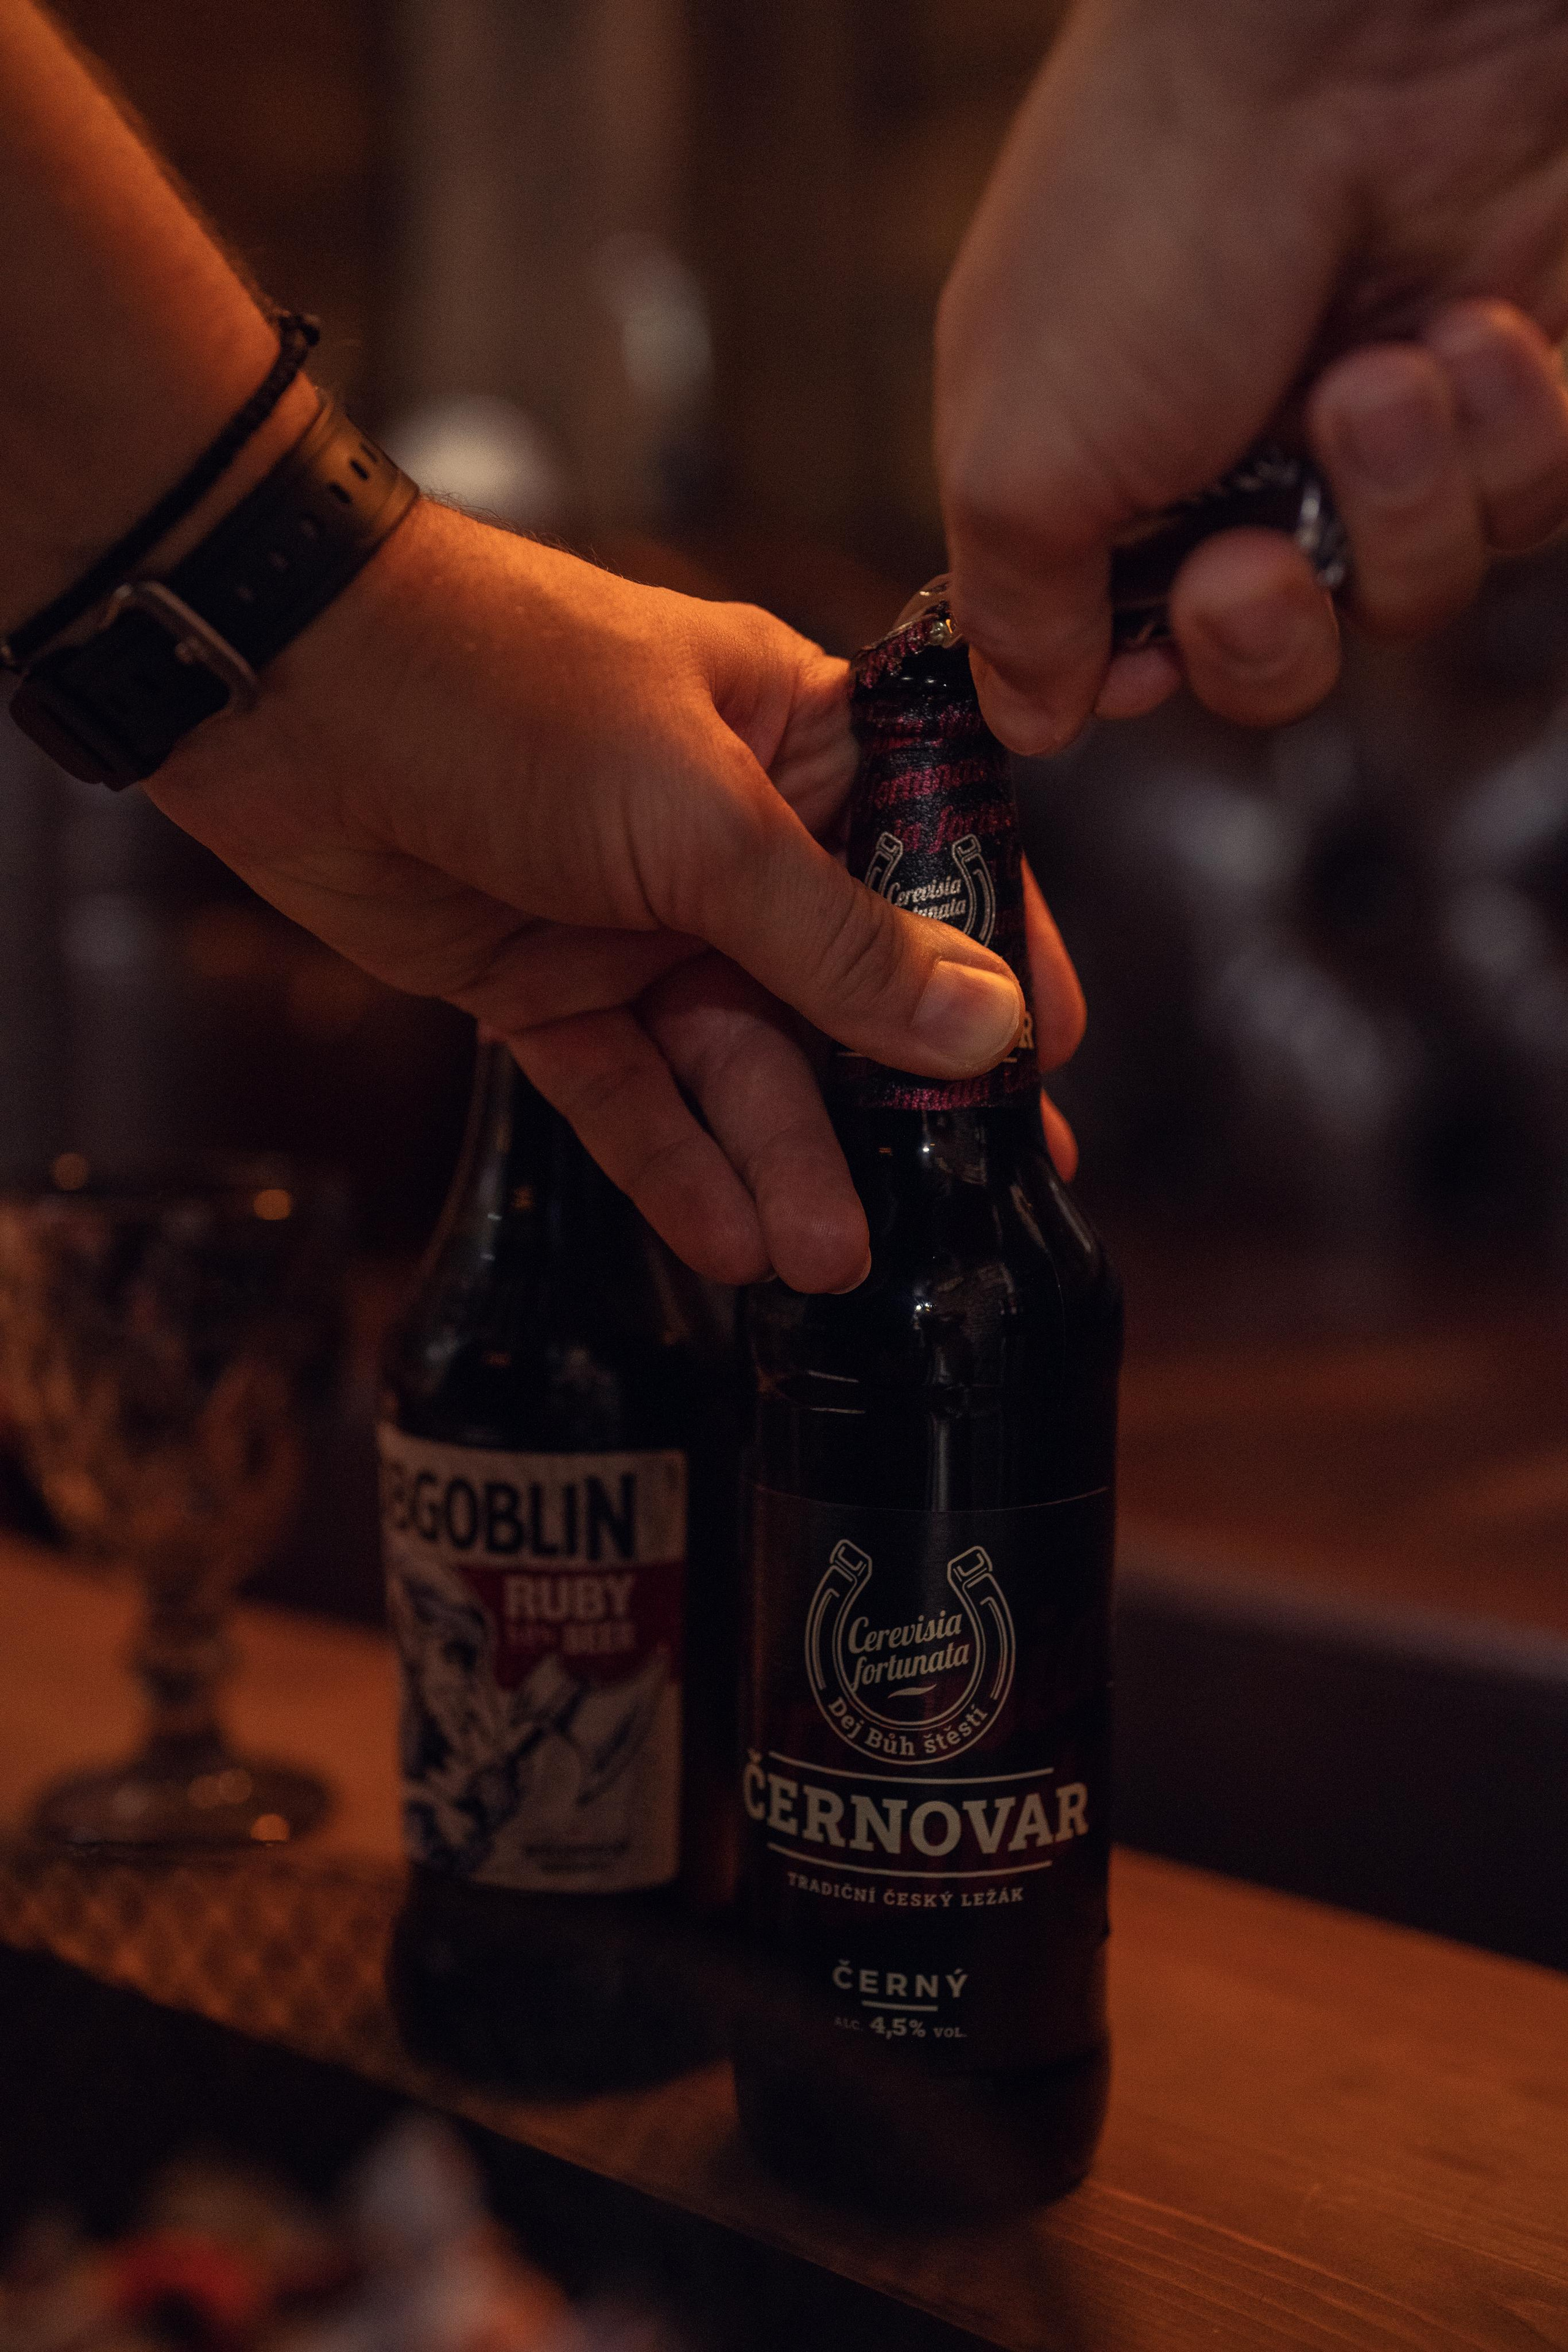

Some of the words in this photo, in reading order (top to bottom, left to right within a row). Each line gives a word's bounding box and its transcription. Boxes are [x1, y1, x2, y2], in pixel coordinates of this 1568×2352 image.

[886, 875, 962, 907] Cerevisia
[503, 1574, 637, 1622] RUBY
[848, 1610, 963, 1654] Cerevisia
[850, 1642, 970, 1692] fortunata
[827, 1695, 866, 1739] Dej
[864, 1727, 916, 1756] Bůh
[923, 1703, 989, 1755] štěstí
[743, 1747, 1089, 1857] ČERNOVAR
[786, 1871, 877, 1904] TRADIČNÍ
[883, 1889, 954, 1908] ČESKÝ
[960, 1885, 1025, 1907] LEŽÁK
[831, 1958, 969, 1999] ČERNÝ
[869, 2016, 927, 2040] 4,5%
